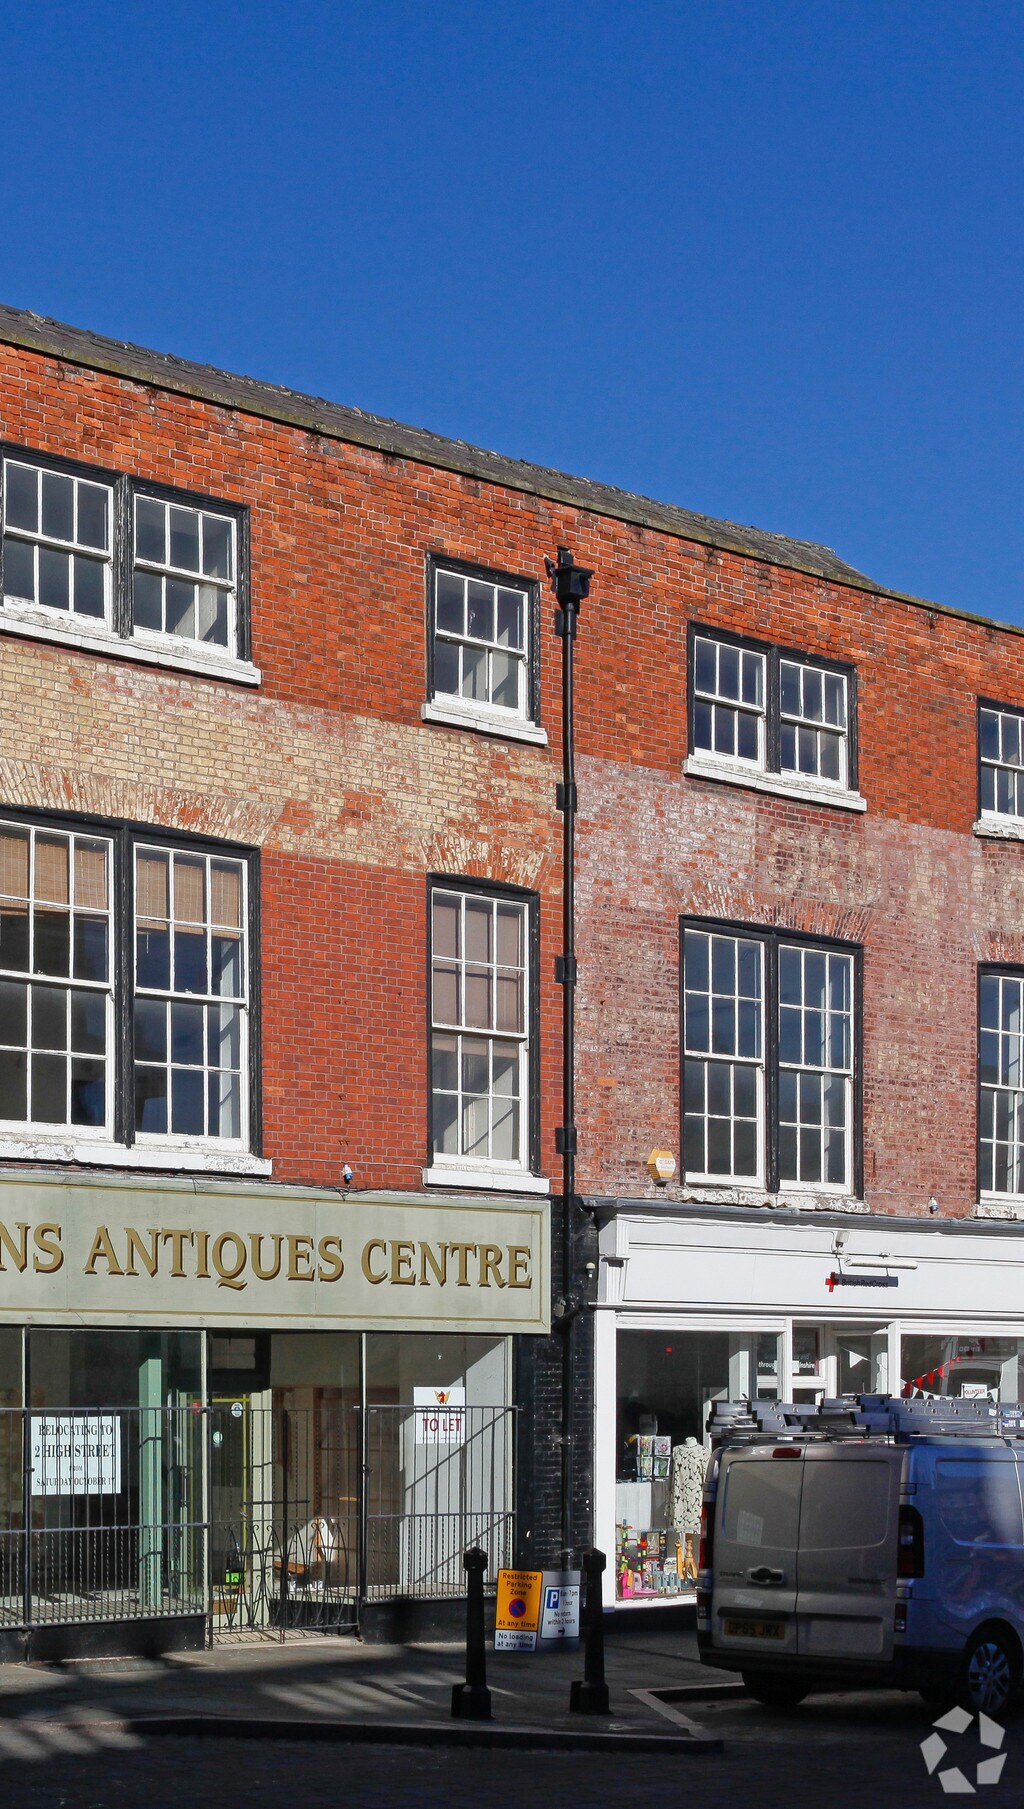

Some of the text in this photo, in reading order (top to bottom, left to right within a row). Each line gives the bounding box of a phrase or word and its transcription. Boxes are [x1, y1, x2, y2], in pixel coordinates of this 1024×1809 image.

[83, 1225, 344, 1291] ANTIQUES
[361, 1239, 532, 1290] CENTRE
[422, 1417, 461, 1432] TO LET
[38, 1424, 112, 1436] RELOCATING TO
[35, 1444, 116, 1457] 2 HIGH STREET
[36, 1477, 72, 1487] SATURDAY
[74, 1476, 107, 1487] OCTOBER
[503, 1572, 538, 1581] Restricted
[507, 1580, 532, 1589] Parking
[510, 1588, 527, 1596] Zone
[498, 1619, 506, 1627] At
[508, 1621, 519, 1629] any
[498, 1632, 534, 1642] No loading
[505, 1642, 517, 1650] any
